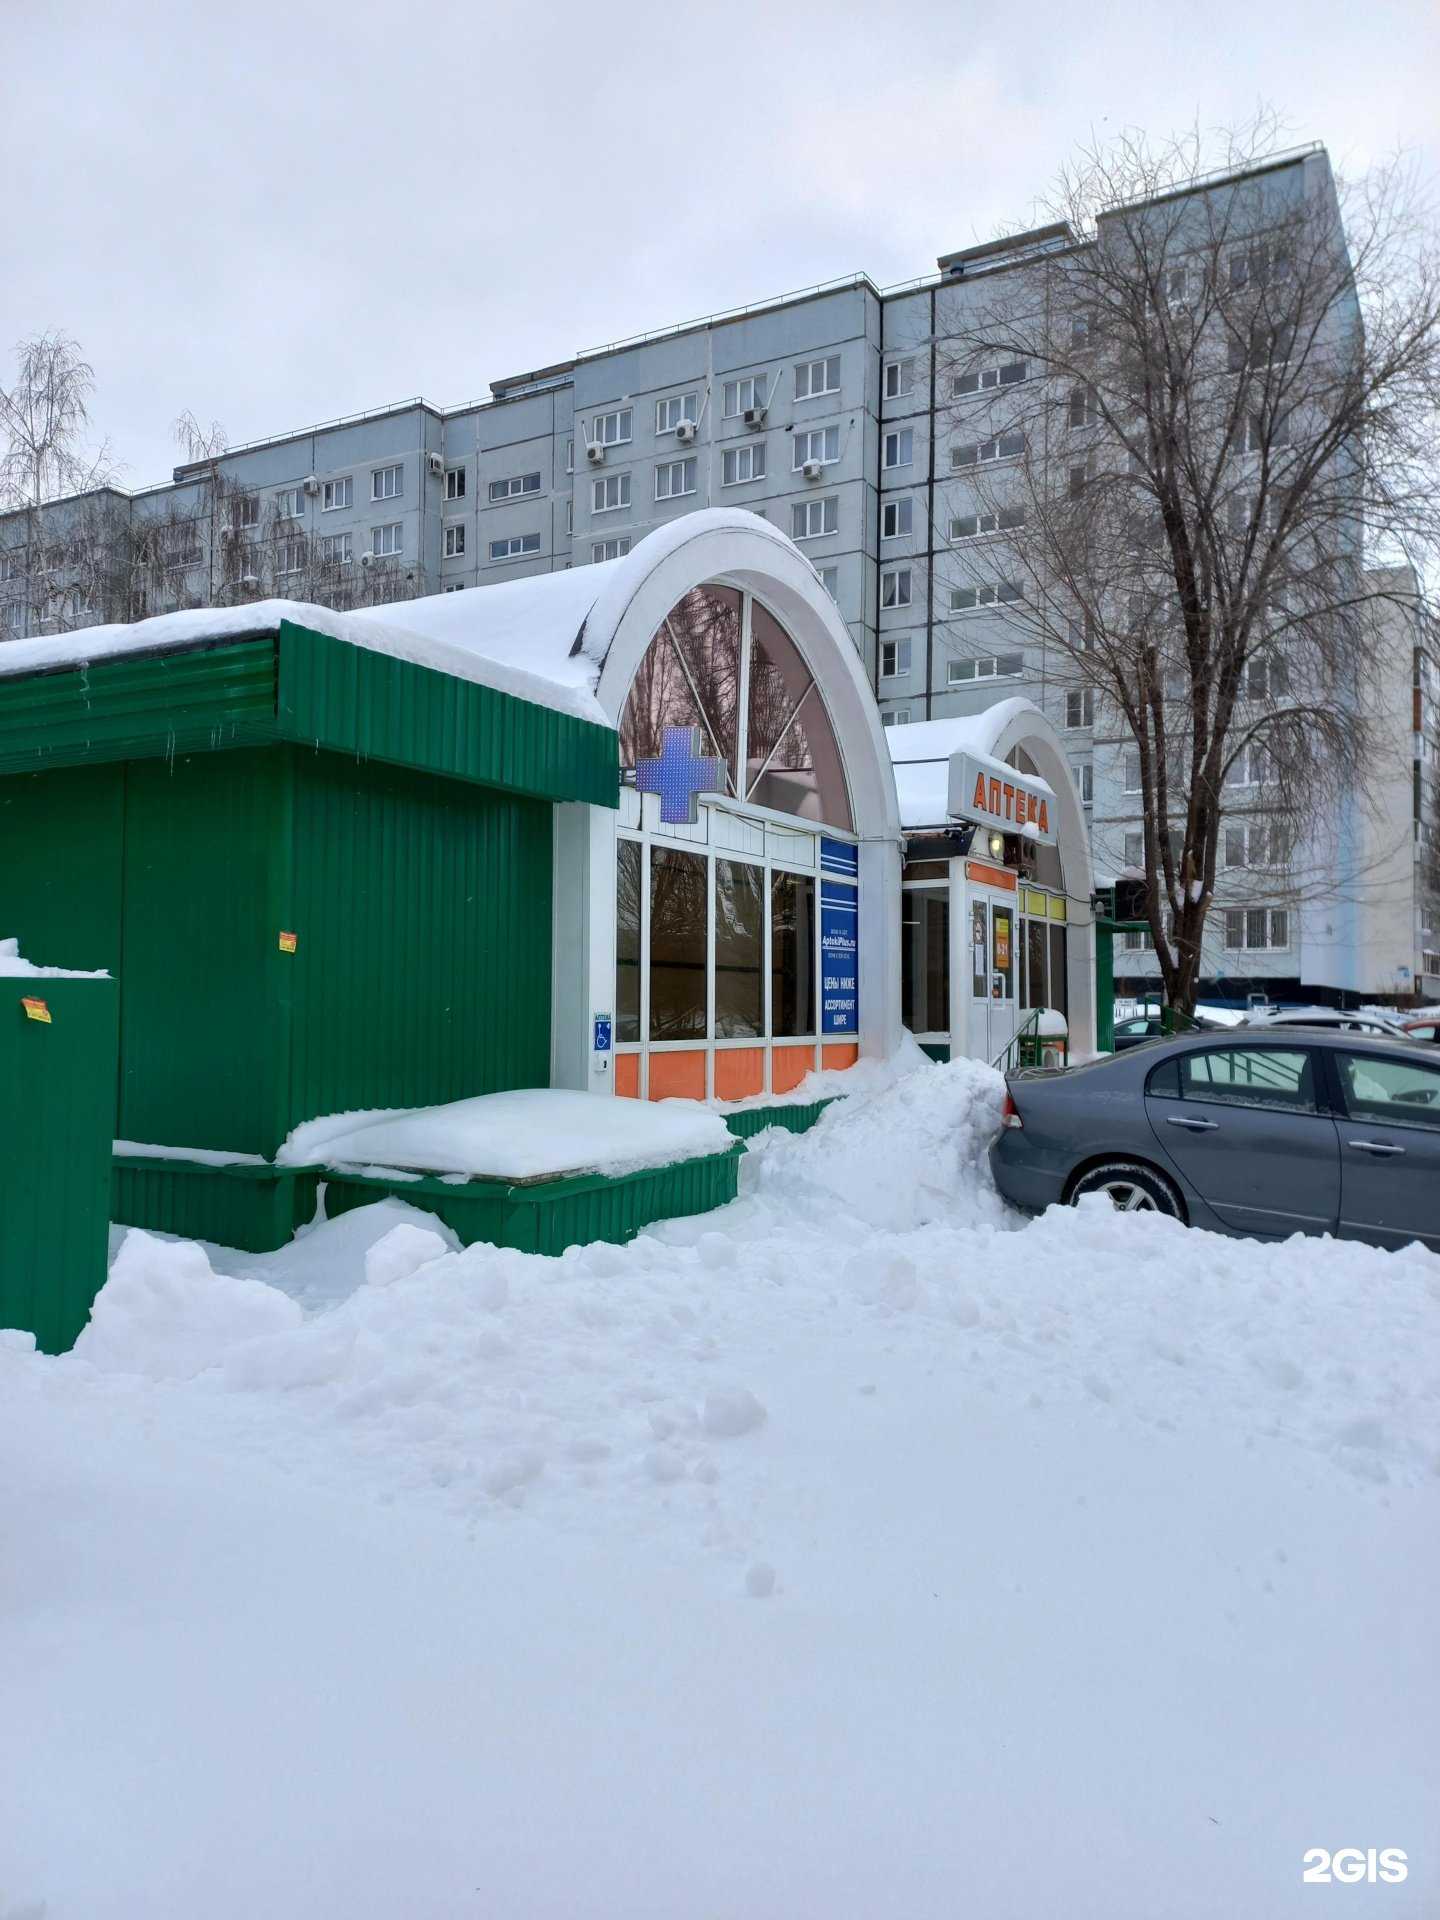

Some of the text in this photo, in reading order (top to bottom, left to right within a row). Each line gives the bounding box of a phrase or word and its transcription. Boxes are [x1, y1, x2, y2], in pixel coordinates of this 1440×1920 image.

[973, 772, 1048, 834] АПТЕКА
[824, 977, 855, 991] ЦЕНЫ НИЖЕ
[824, 999, 855, 1010] АССОРТИМЕНТ
